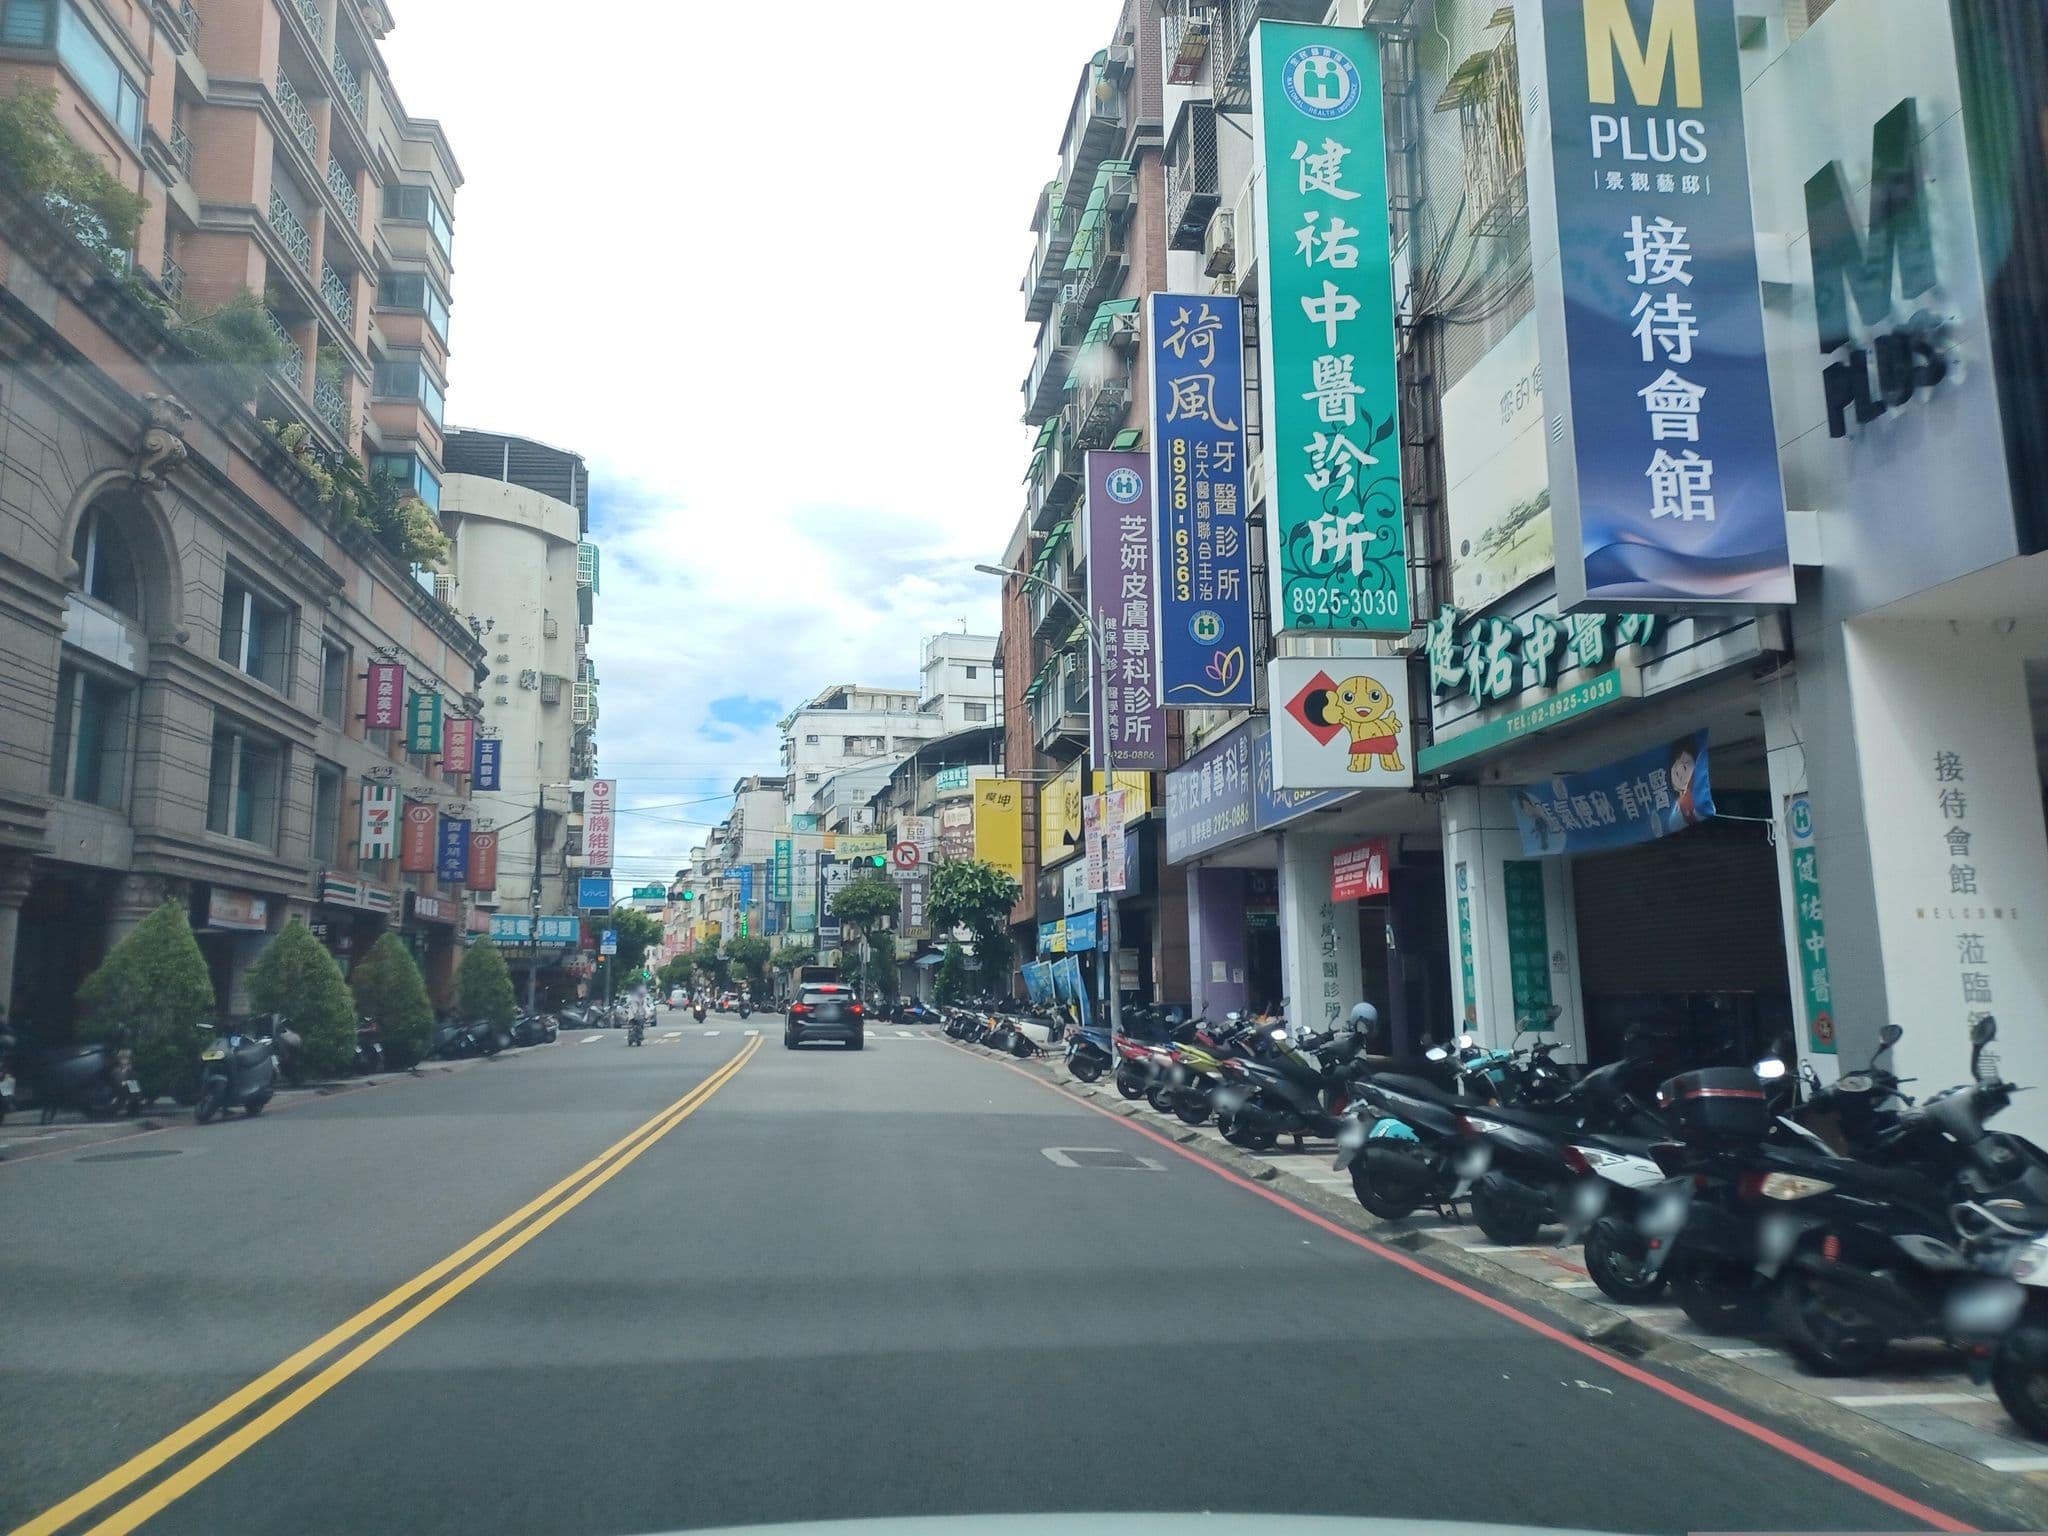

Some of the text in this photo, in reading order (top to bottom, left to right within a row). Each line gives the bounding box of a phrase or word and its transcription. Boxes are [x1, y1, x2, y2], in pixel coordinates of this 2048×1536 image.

[1582, 0, 1702, 108] M
[1589, 115, 1708, 165] PLUS
[1162, 303, 1240, 432] 荷風
[1290, 137, 1379, 577] 健祐中醫診所
[1623, 216, 1715, 523] 接待會館
[1173, 439, 1190, 601] 8928-6363
[1195, 440, 1213, 601] 台大醫師聯合主治
[1212, 441, 1241, 602] 牙醫診所
[1120, 515, 1152, 743] 芝妍皮膚專科診所
[1293, 587, 1399, 616] 8925-3030
[588, 800, 610, 866] 手機維修
[1933, 750, 1978, 895] 接待會館
[1796, 855, 1830, 1003] 健祐中醫
